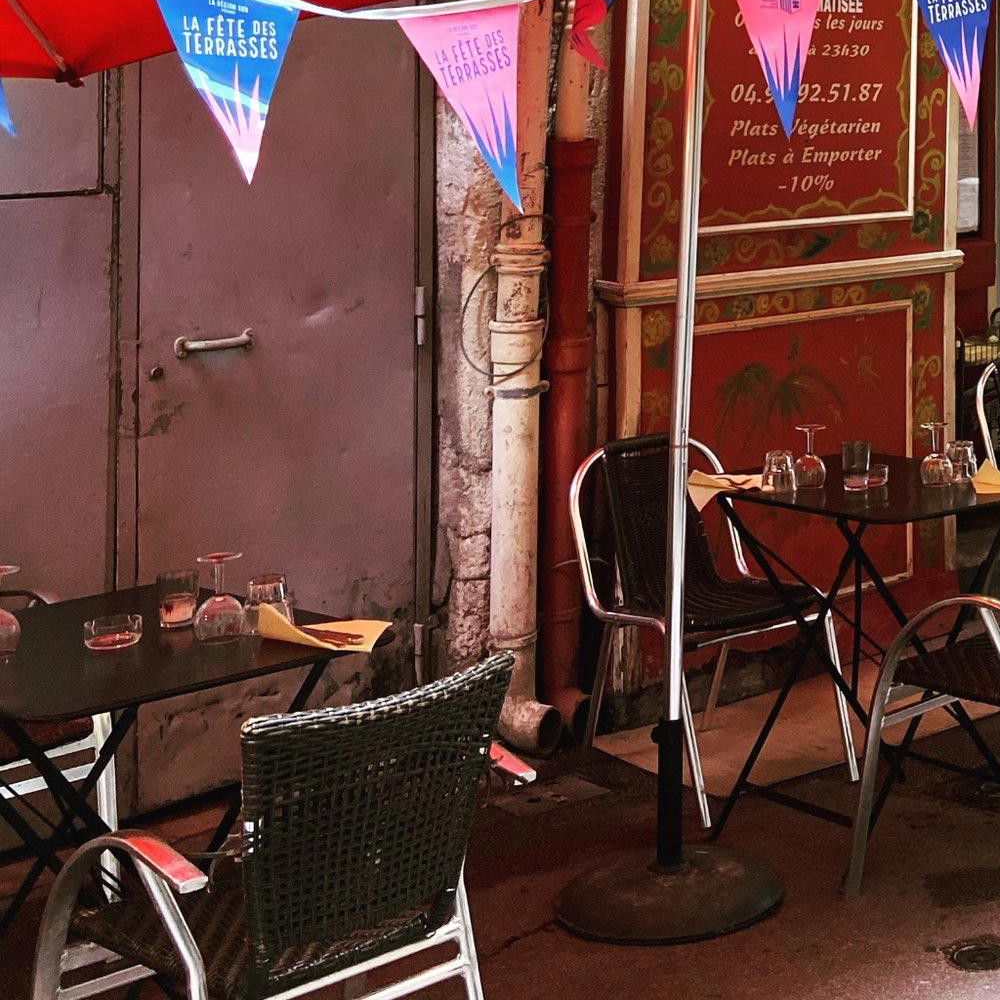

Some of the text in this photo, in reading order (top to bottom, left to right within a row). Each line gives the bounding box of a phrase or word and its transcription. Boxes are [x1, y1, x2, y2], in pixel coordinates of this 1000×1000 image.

[183, 14, 276, 38] LA FÊTE DES
[826, 14, 844, 30] les
[848, 14, 884, 33] jours
[182, 31, 278, 60] TERRASSES
[434, 49, 449, 65] LA
[451, 37, 482, 63] FÊTE
[485, 29, 504, 48] DES
[822, 44, 870, 58] 23h30
[440, 46, 511, 88] TERRASSES
[730, 119, 779, 138] Plats
[728, 146, 882, 167] Plats à Emporter
[778, 174, 835, 193] -10%
